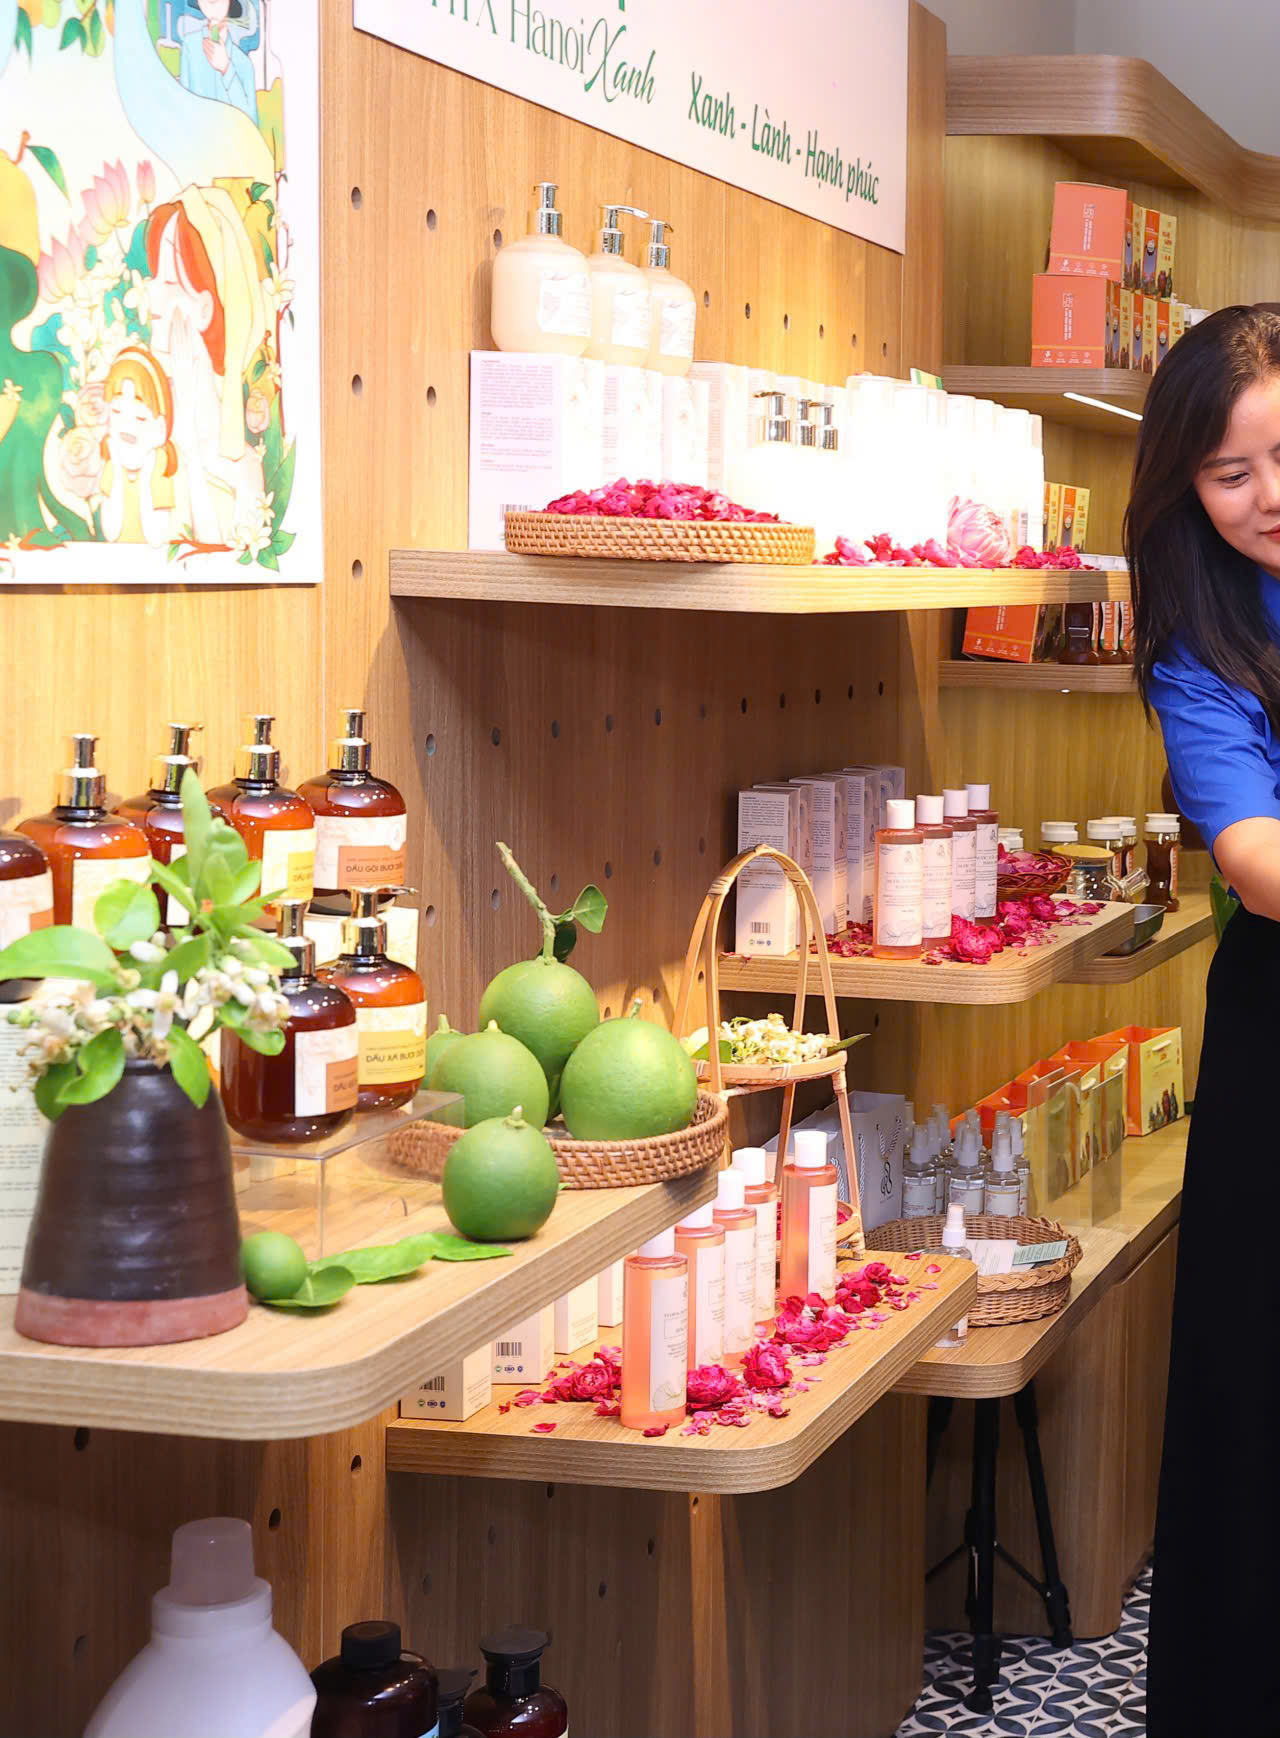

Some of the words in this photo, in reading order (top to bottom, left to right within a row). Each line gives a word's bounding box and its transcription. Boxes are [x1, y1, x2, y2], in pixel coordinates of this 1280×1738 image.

[688, 71, 736, 139] Xanh
[752, 104, 791, 165] Lành
[805, 129, 844, 189] Hạnh
[846, 157, 880, 205] phúc
